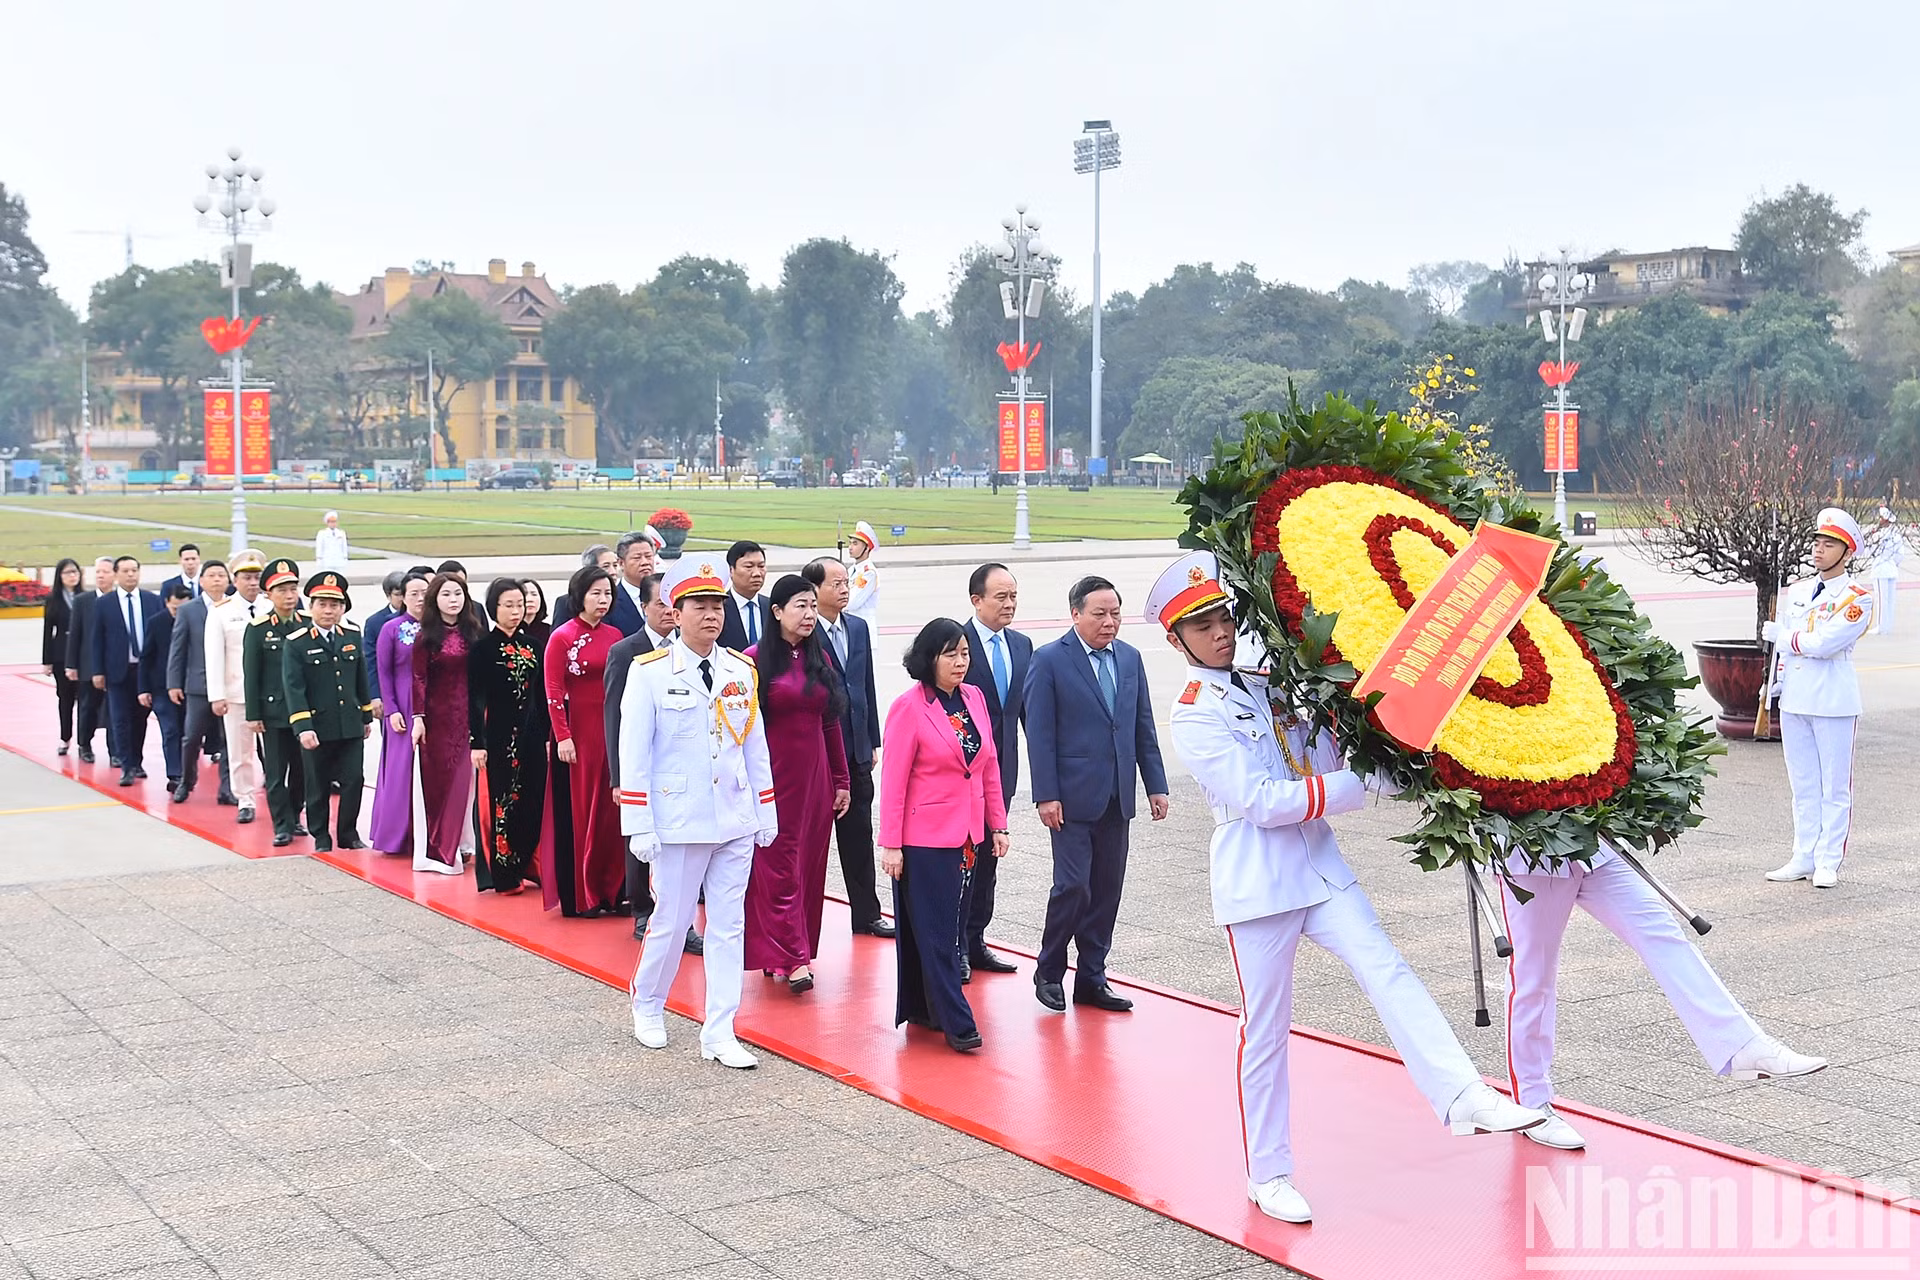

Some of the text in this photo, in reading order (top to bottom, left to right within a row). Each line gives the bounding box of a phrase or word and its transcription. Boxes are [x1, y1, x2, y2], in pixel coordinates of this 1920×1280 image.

[1444, 588, 1475, 614] TỊCH
[1430, 600, 1464, 628] CHỦ
[1424, 619, 1454, 640] ƠN
[1412, 629, 1444, 658] NHỚ
[1398, 648, 1432, 672] ĐỜI
[1387, 664, 1422, 688] ĐỜI
